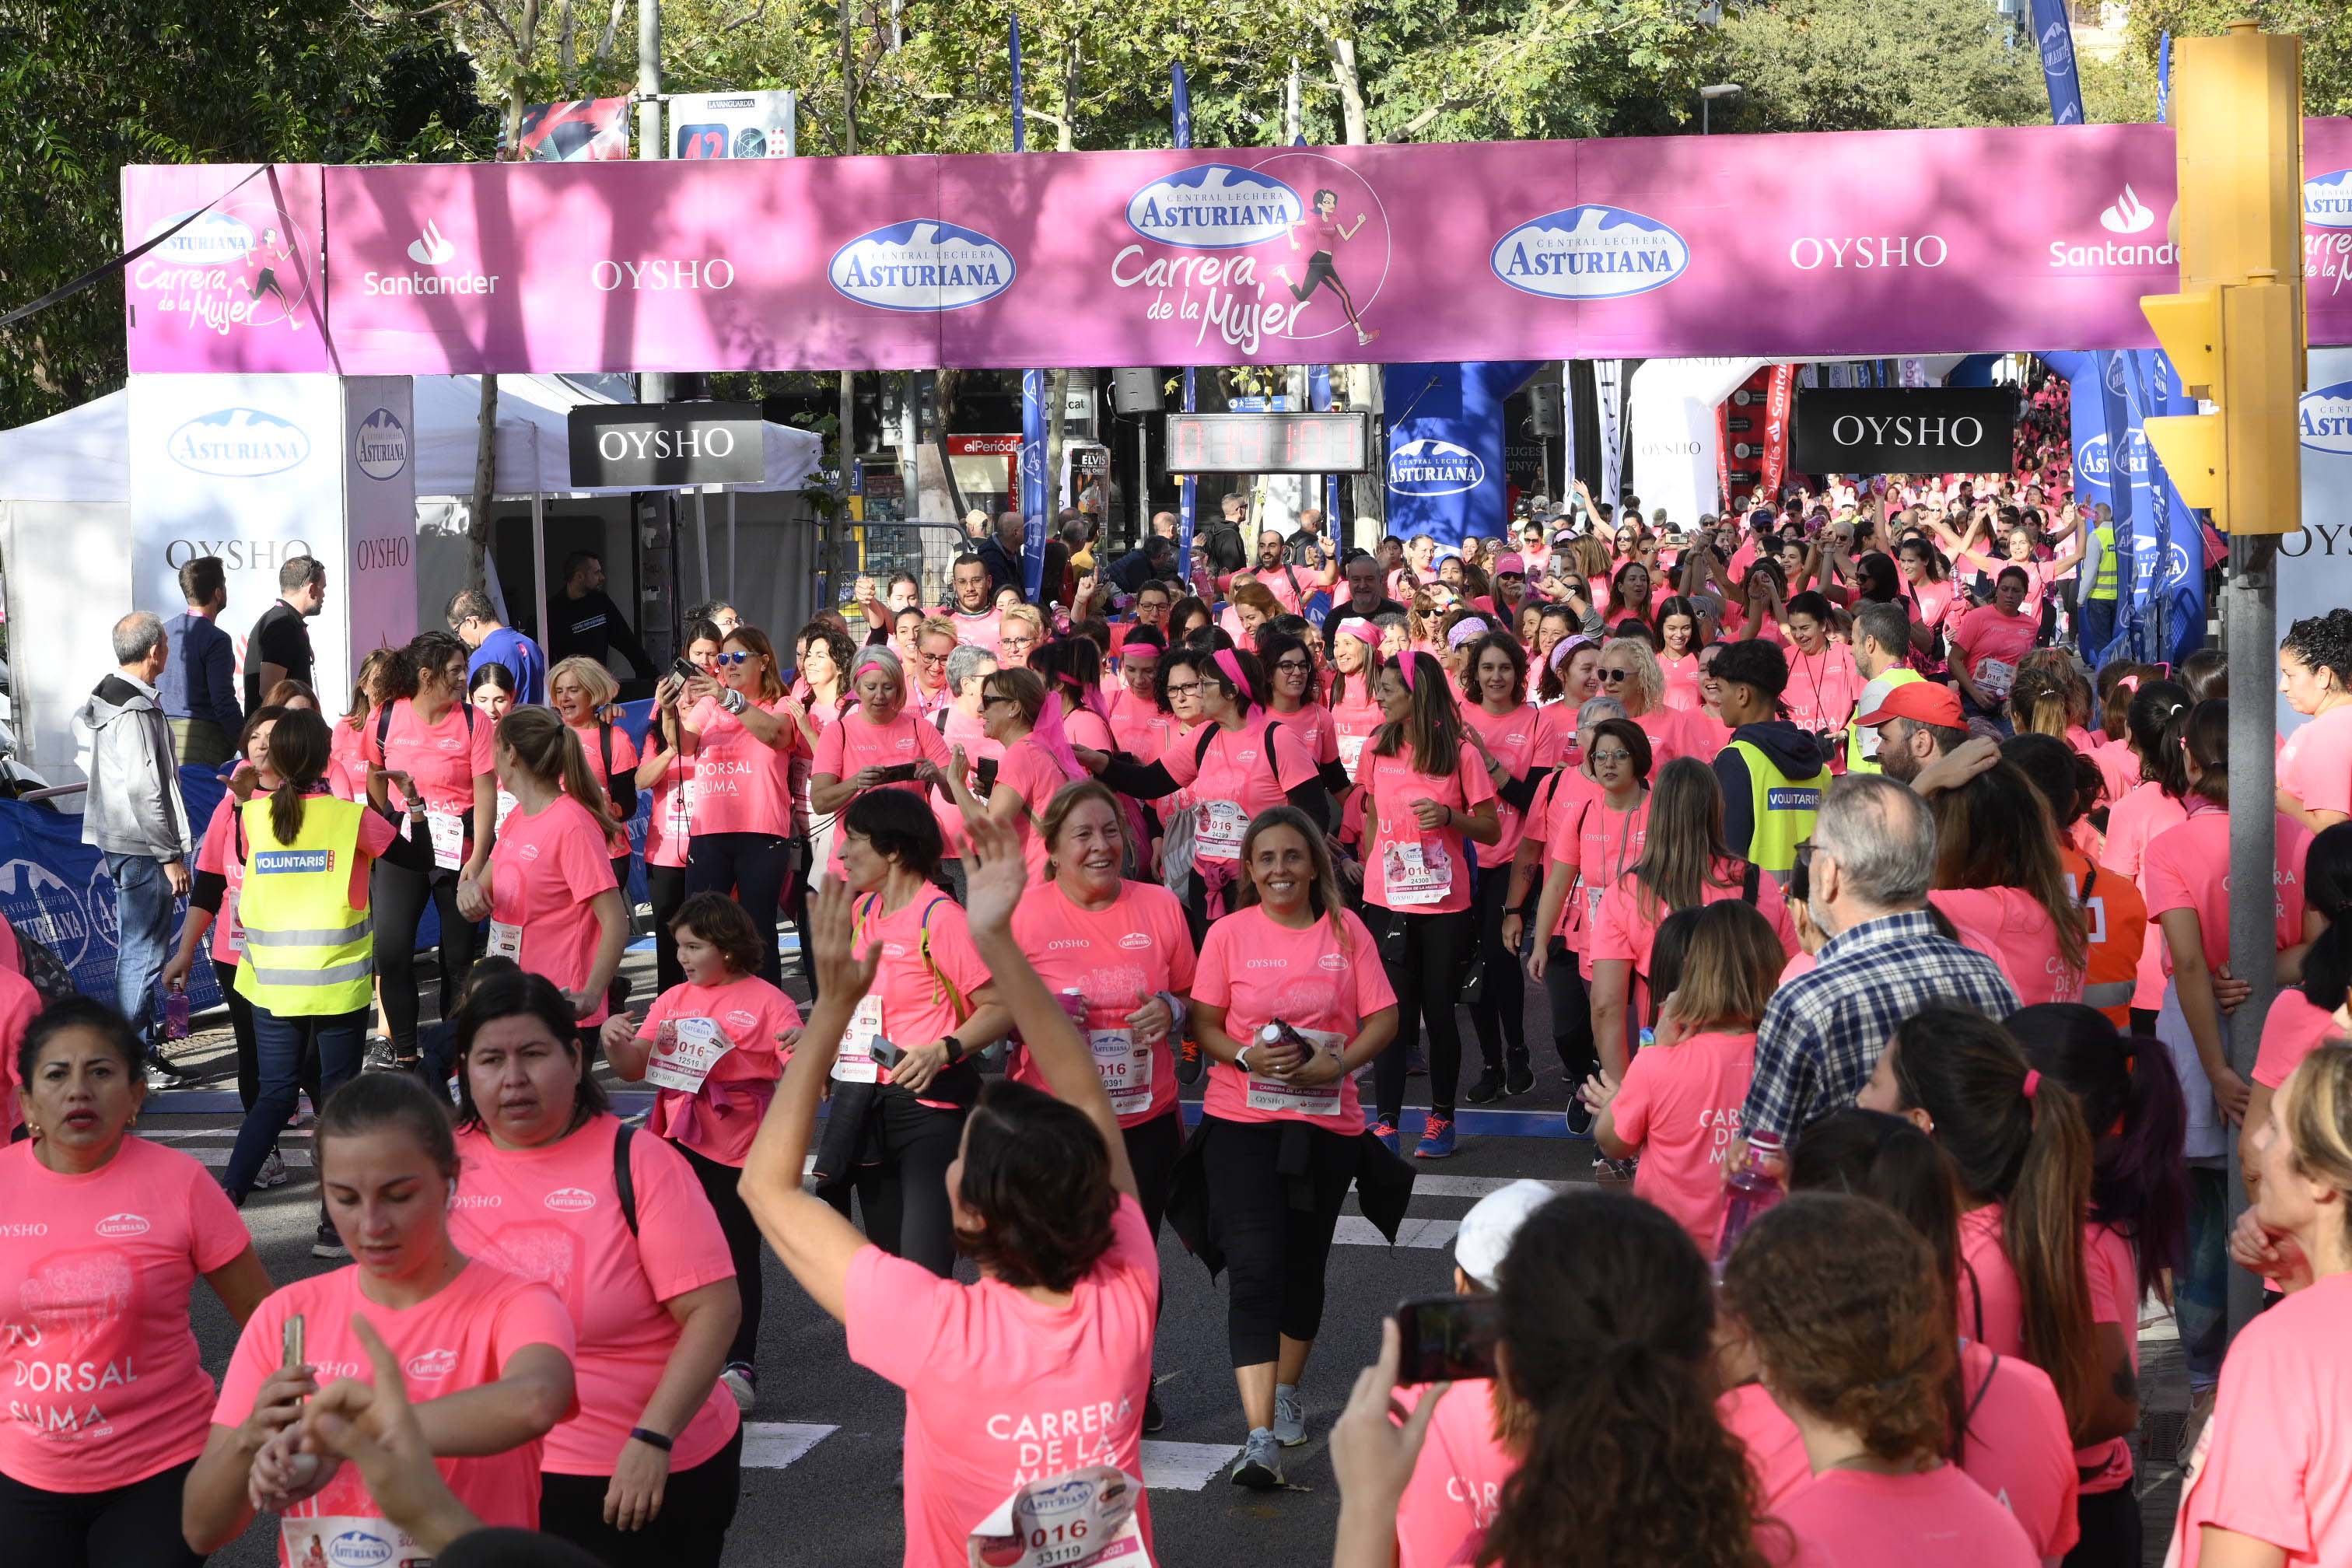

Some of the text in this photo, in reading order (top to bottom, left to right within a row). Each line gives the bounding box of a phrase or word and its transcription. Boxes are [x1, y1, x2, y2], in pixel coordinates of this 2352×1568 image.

[1167, 191, 1284, 202] CENTRAL LECHERA
[1140, 198, 1287, 229] ASTURIANA
[1537, 234, 1668, 248] CENTRAL LECHERA
[1790, 234, 1948, 270] OYSHO
[872, 250, 928, 261] CENTRAL
[1507, 241, 1673, 277] ASTURIANA
[2049, 241, 2181, 267] Santand
[135, 261, 227, 291] Carrera
[591, 258, 735, 290] OYSHO
[842, 252, 1001, 289] ASTURIANA
[1111, 244, 1257, 289] Carrera
[363, 271, 499, 296] Santander
[158, 287, 261, 336] de la Mujer
[1146, 282, 1311, 355] de la Mujer
[2320, 404, 2352, 414] CENT
[1832, 415, 1984, 448] OYSHO
[180, 434, 300, 460] ASTURIANA
[359, 434, 404, 464] ASTURIANA
[599, 427, 735, 462] OYSHO
[1082, 455, 1106, 465] ELVIS
[1389, 462, 1478, 484] ASTURIANA
[2278, 523, 2352, 557] OYS
[357, 536, 409, 572] OYSHO
[696, 761, 753, 777] DORSAL
[699, 780, 737, 795] SUMA
[1212, 821, 1231, 831] 016
[256, 856, 325, 869] VOLUNTARIS
[1408, 867, 1430, 876] 016
[1048, 939, 1090, 950] OYSHO
[1247, 958, 1287, 969] OYSHO
[678, 1041, 705, 1058] 016
[1093, 1042, 1129, 1053] ASTURIANA
[656, 1061, 678, 1073] CARRERA
[678, 1055, 700, 1068] 12519
[1255, 1094, 1285, 1106] OYSHO
[1259, 1085, 1286, 1094] CARRERA
[548, 1195, 593, 1209] ASTURIANA
[101, 1222, 145, 1233] ASTURIANA
[14, 1356, 138, 1393] DORSAL
[10, 1400, 107, 1433] SUMA
[986, 1393, 1132, 1441] CARRERA
[1020, 1430, 1113, 1468] DE LA
[1031, 1519, 1087, 1550] 016
[333, 1544, 387, 1559] ASTURIANA
